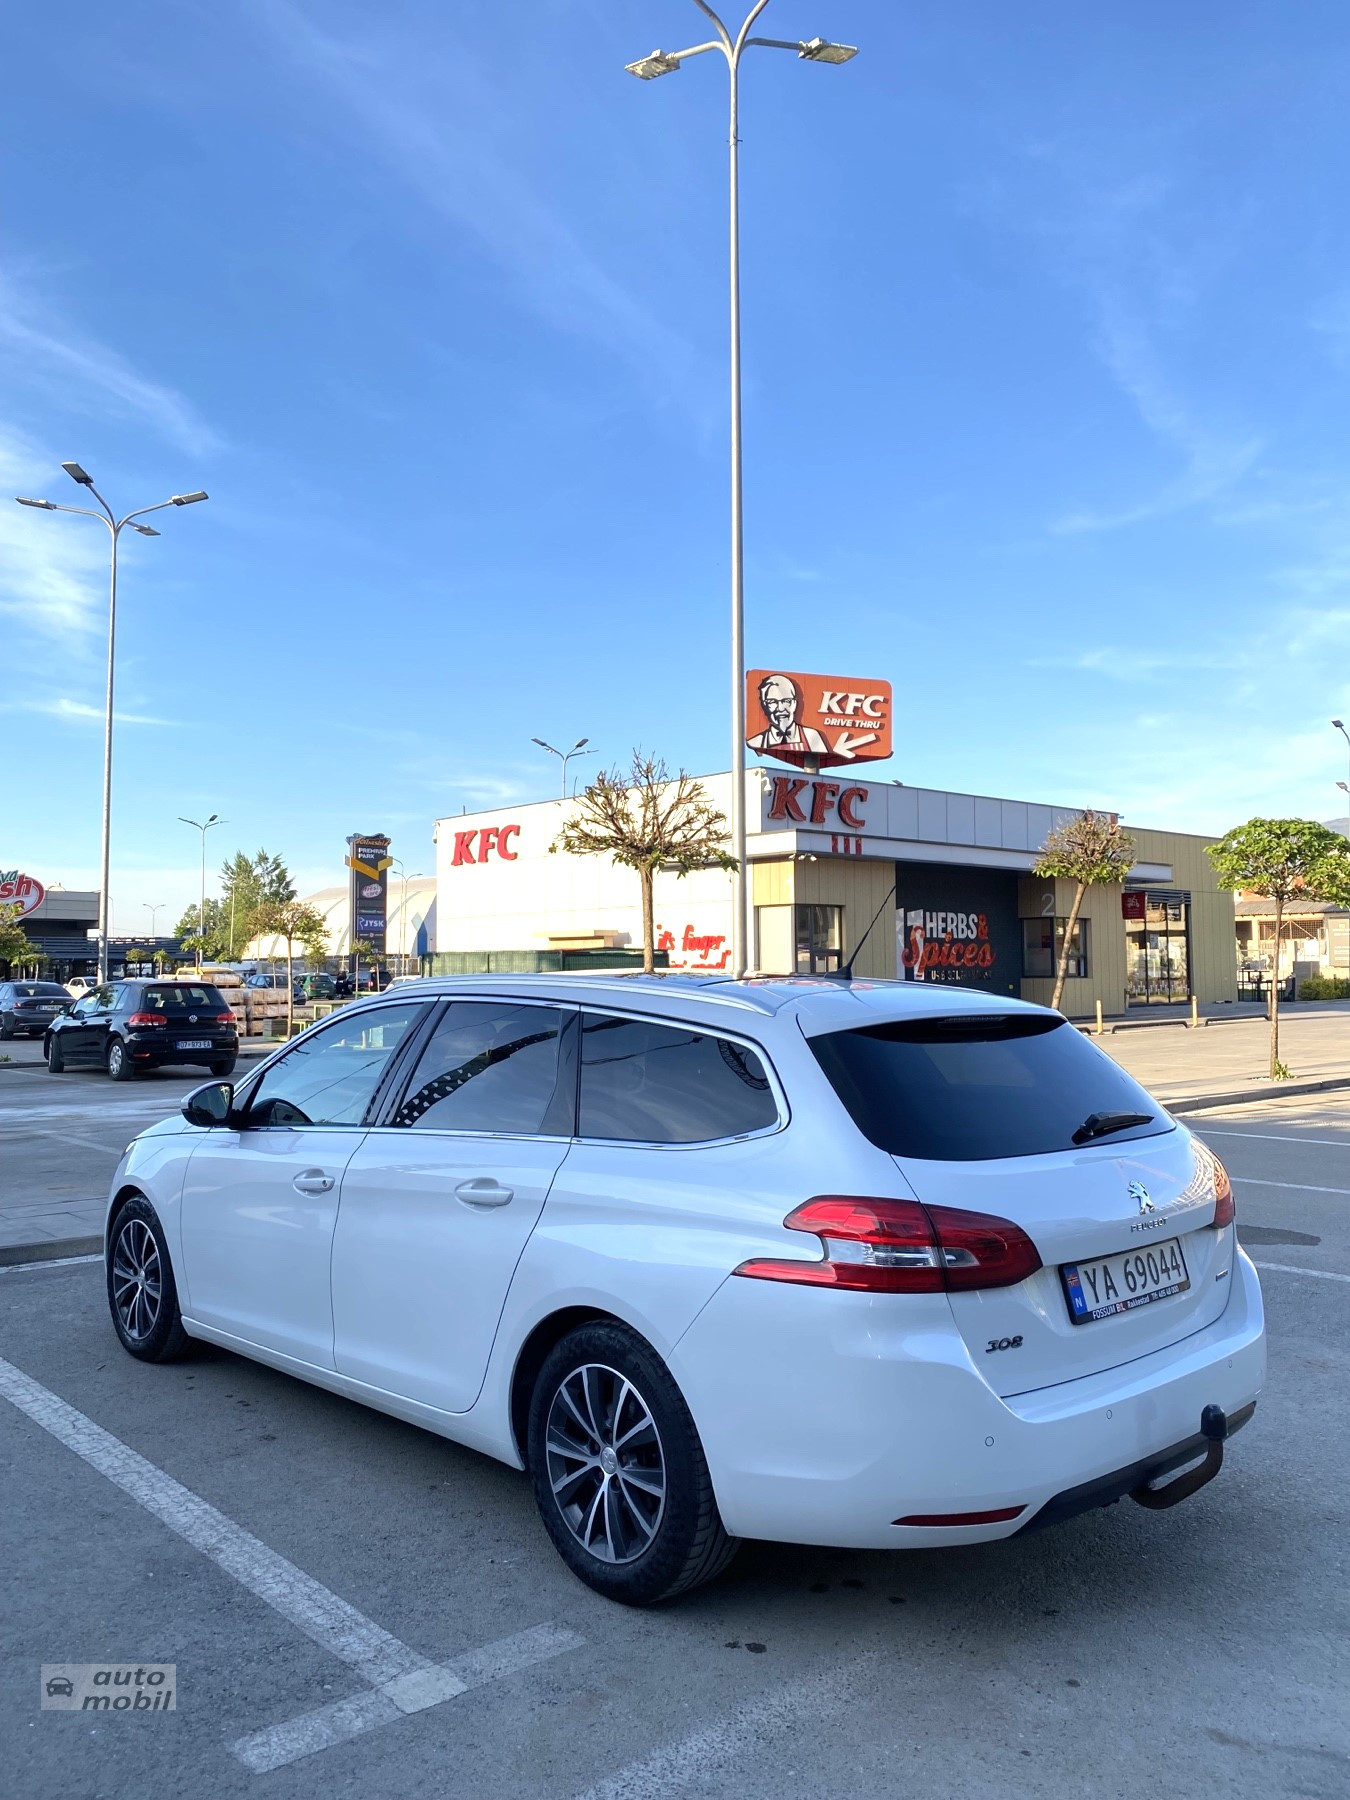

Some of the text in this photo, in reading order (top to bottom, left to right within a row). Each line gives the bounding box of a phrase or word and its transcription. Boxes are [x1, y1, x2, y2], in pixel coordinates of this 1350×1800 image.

[818, 691, 884, 717] KFC
[824, 717, 880, 729] DRIVE THRU
[768, 777, 869, 828] KFC
[358, 847, 386, 856] PREMIUM
[451, 824, 521, 866] KFC
[1041, 893, 1055, 916] 2
[902, 925, 995, 978] Spices
[1131, 1217, 1168, 1232] PEUGEOT
[1084, 1246, 1181, 1304] YA 69044
[1075, 1297, 1083, 1308] N
[1092, 1304, 1116, 1320] FOSSUM
[985, 1335, 1024, 1354] 308
